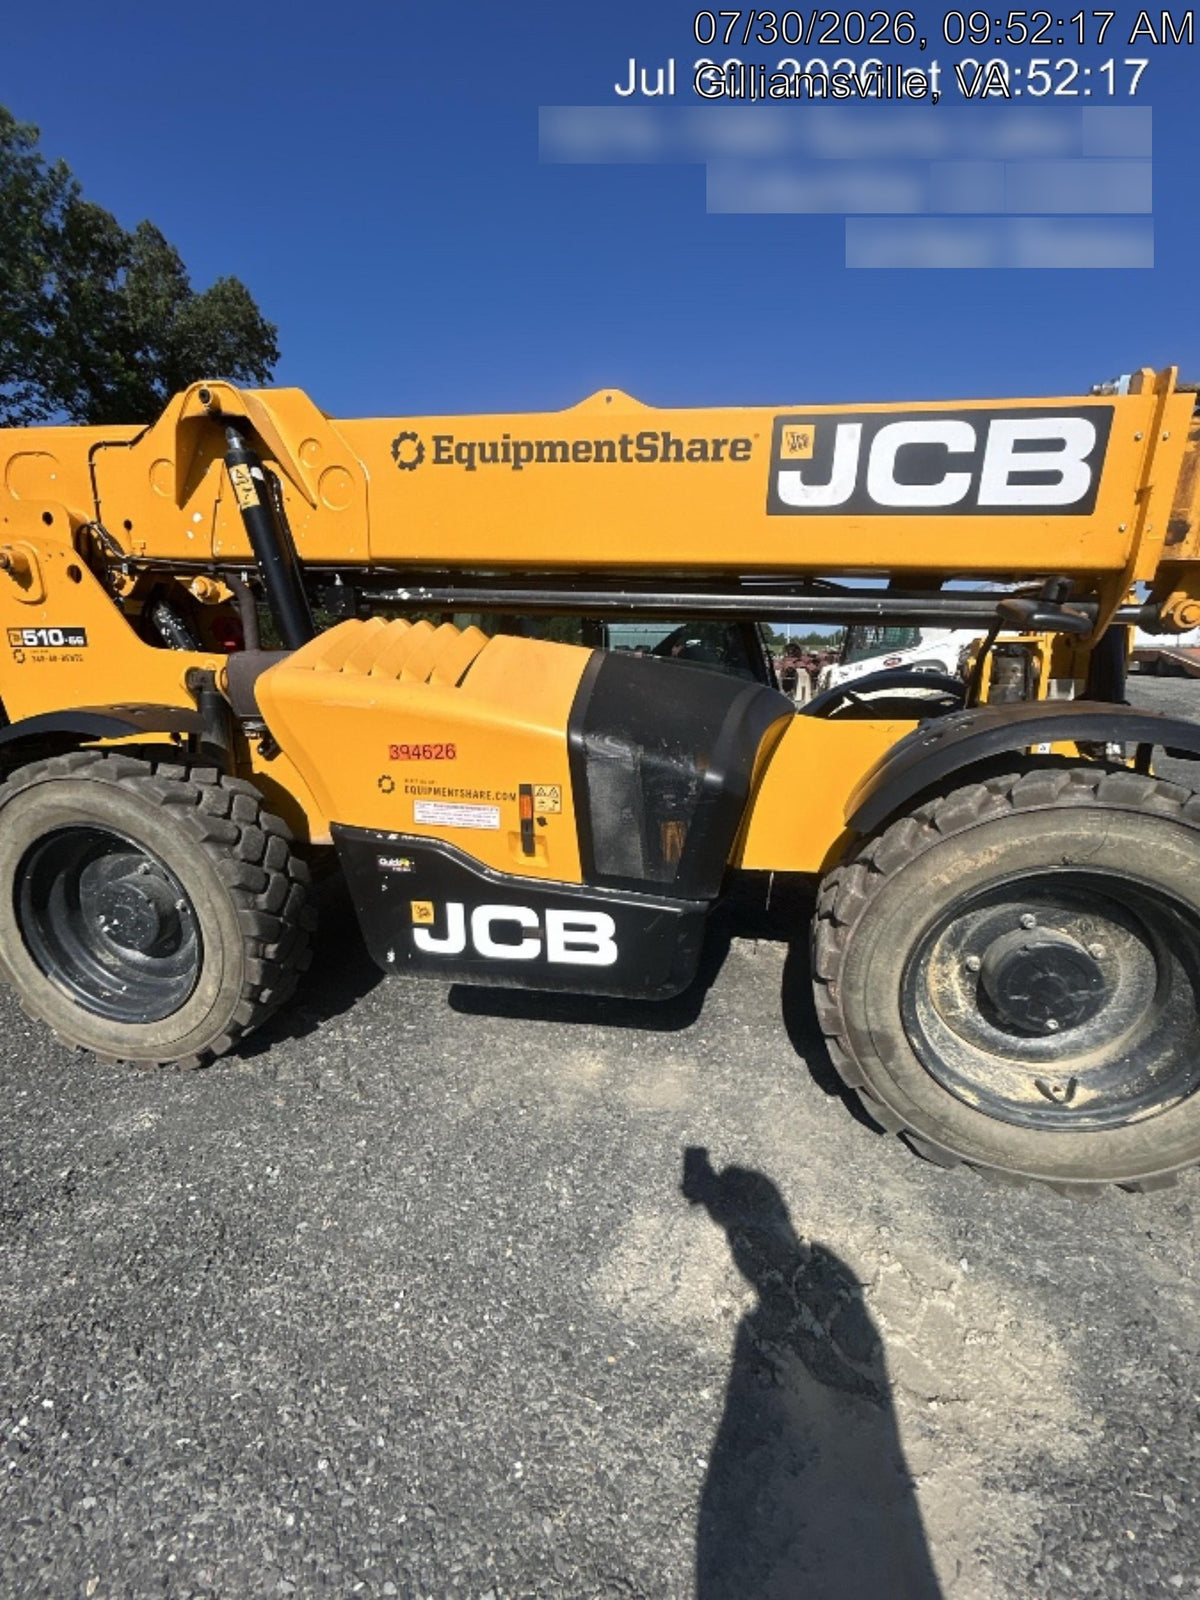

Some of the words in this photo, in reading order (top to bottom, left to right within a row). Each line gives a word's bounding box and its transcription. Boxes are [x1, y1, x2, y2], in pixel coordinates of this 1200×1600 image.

[431, 431, 753, 471] EquipmentShare
[777, 417, 1097, 507] JCB
[389, 743, 457, 761] 394626
[404, 785, 517, 802] EQUIPMENTSHARE.COM
[413, 902, 619, 966] JCB
